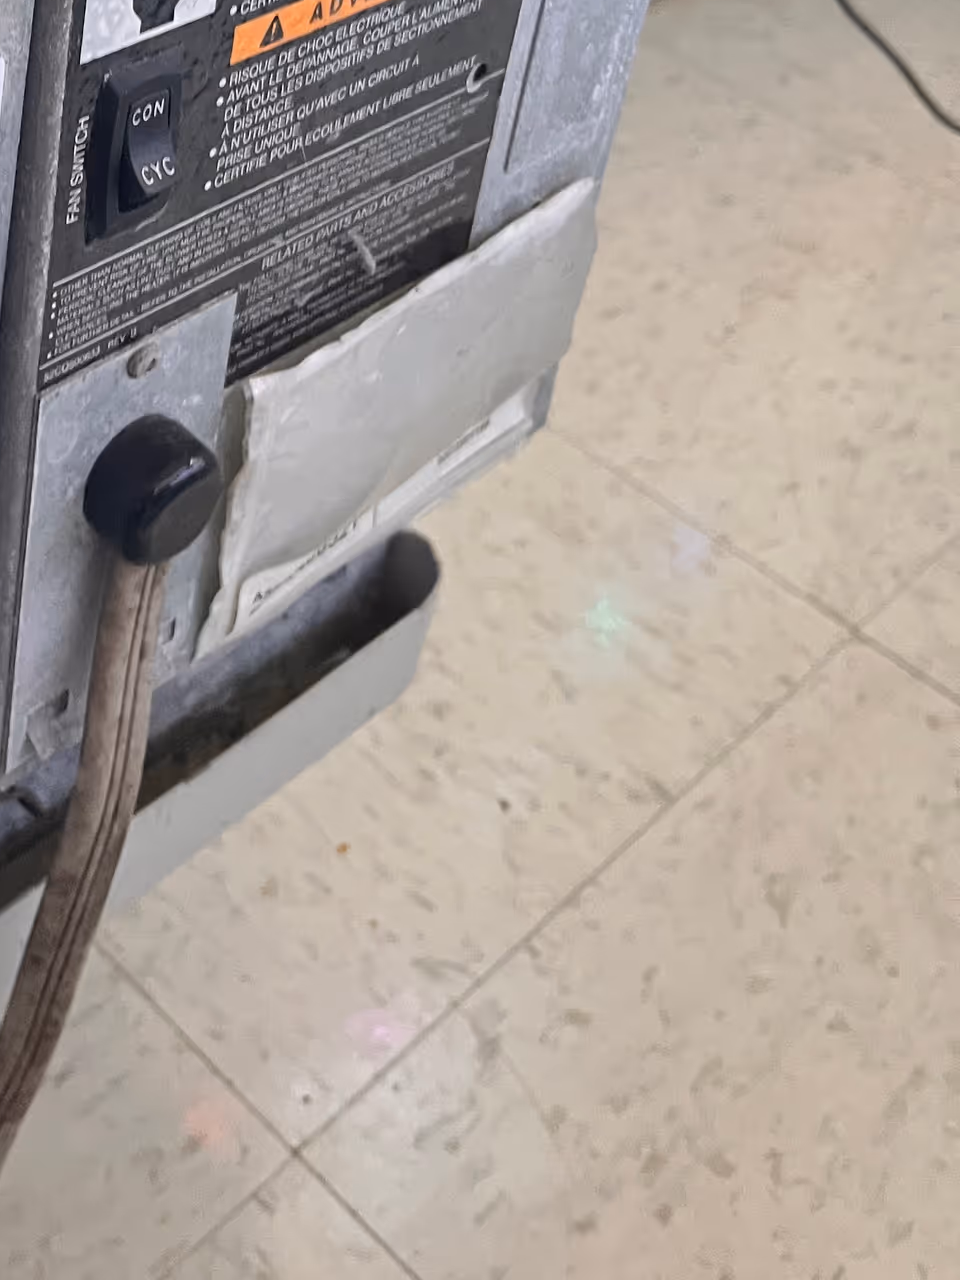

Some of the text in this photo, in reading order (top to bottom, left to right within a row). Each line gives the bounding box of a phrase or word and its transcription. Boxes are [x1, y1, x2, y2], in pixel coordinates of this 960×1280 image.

[224, 103, 242, 122] DE
[245, 87, 278, 111] TOUS
[281, 77, 303, 97] LES
[305, 46, 374, 85] DISPOSITIFS
[376, 37, 391, 55] DE
[226, 74, 267, 105] AVANT
[269, 70, 283, 86] LE
[363, 15, 410, 45] COUPER
[229, 33, 334, 88] RISQUE DE CHOC
[132, 98, 165, 126] CON
[230, 60, 410, 151] N'UTILISER QU'AVEC UN CIRCUIT
[269, 85, 413, 163] POUR LIBRE
[66, 114, 90, 225] FAN SWITCH
[141, 156, 175, 186] CYC
[216, 147, 251, 172] PRISE
[262, 159, 455, 271] RELATED PARTS AND ACCESSORIES
